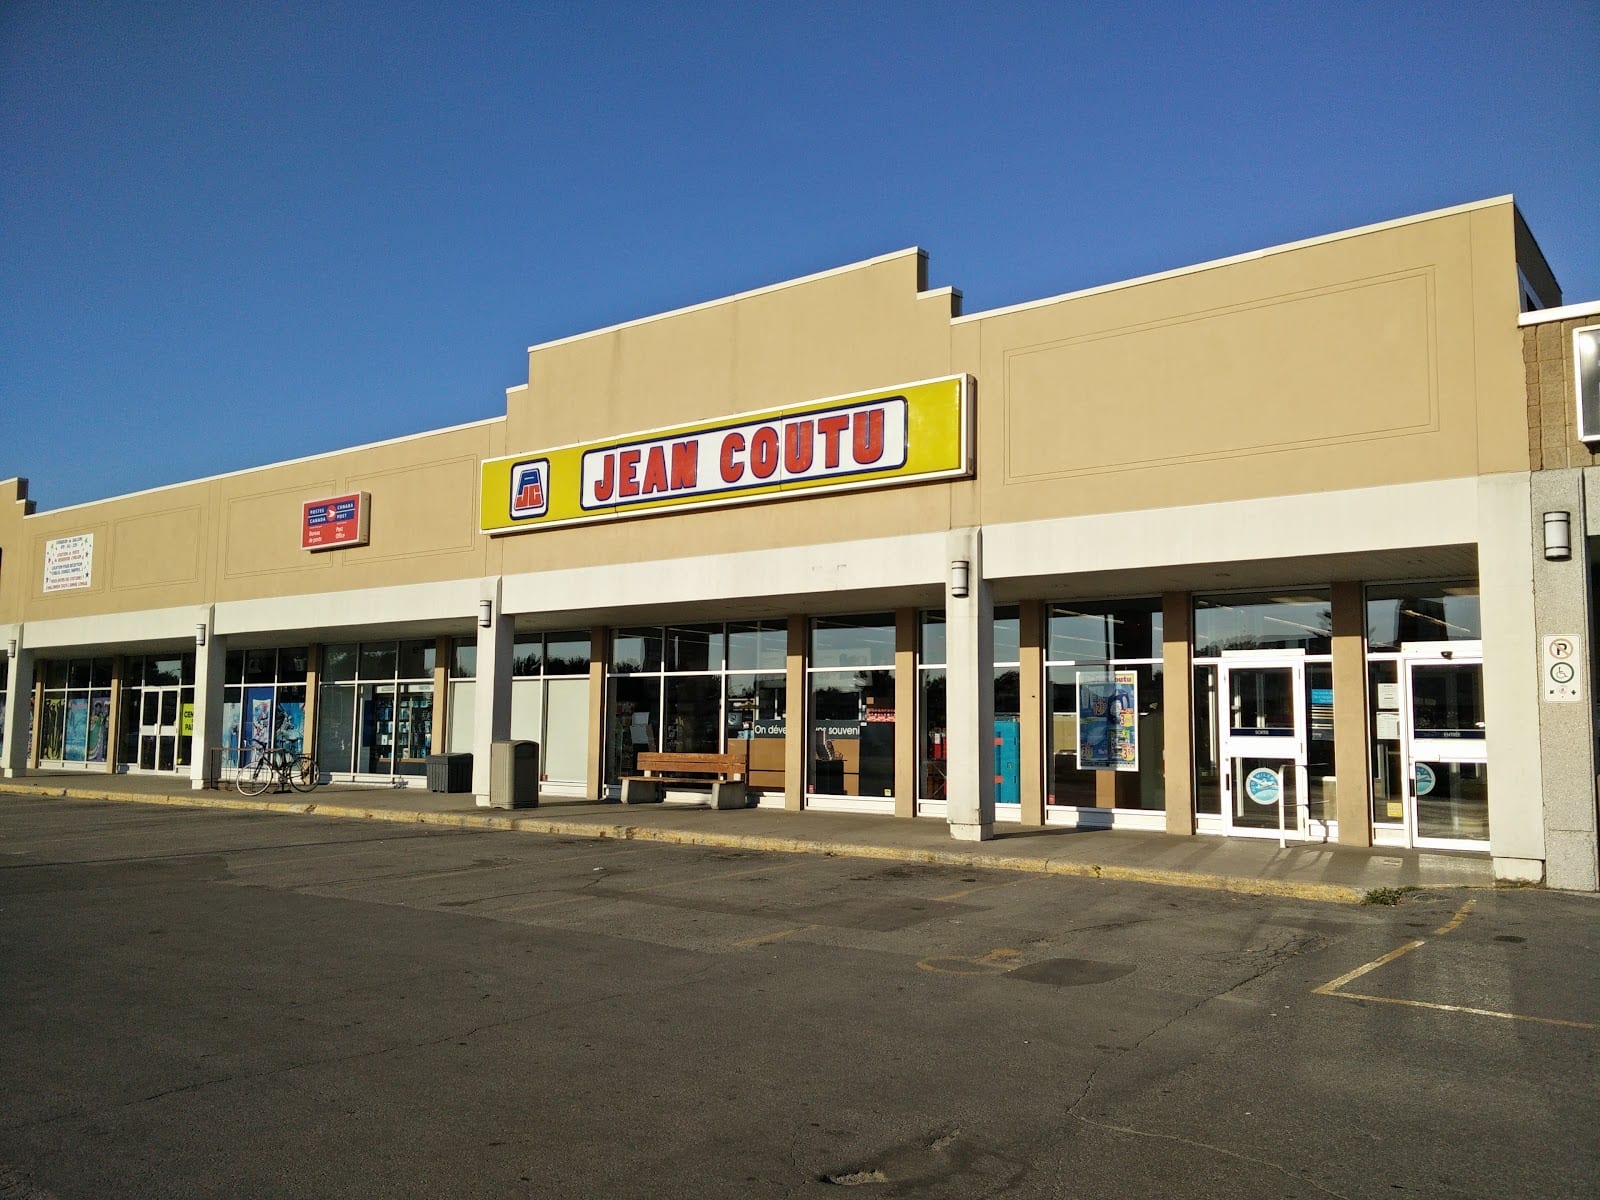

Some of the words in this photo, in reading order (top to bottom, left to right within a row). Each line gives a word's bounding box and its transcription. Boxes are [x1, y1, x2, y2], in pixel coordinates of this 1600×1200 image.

[594, 440, 698, 501] JEAN
[720, 408, 885, 483] COUTU
[754, 725, 766, 734] On
[768, 724, 786, 734] déve
[828, 725, 860, 735] souveni
